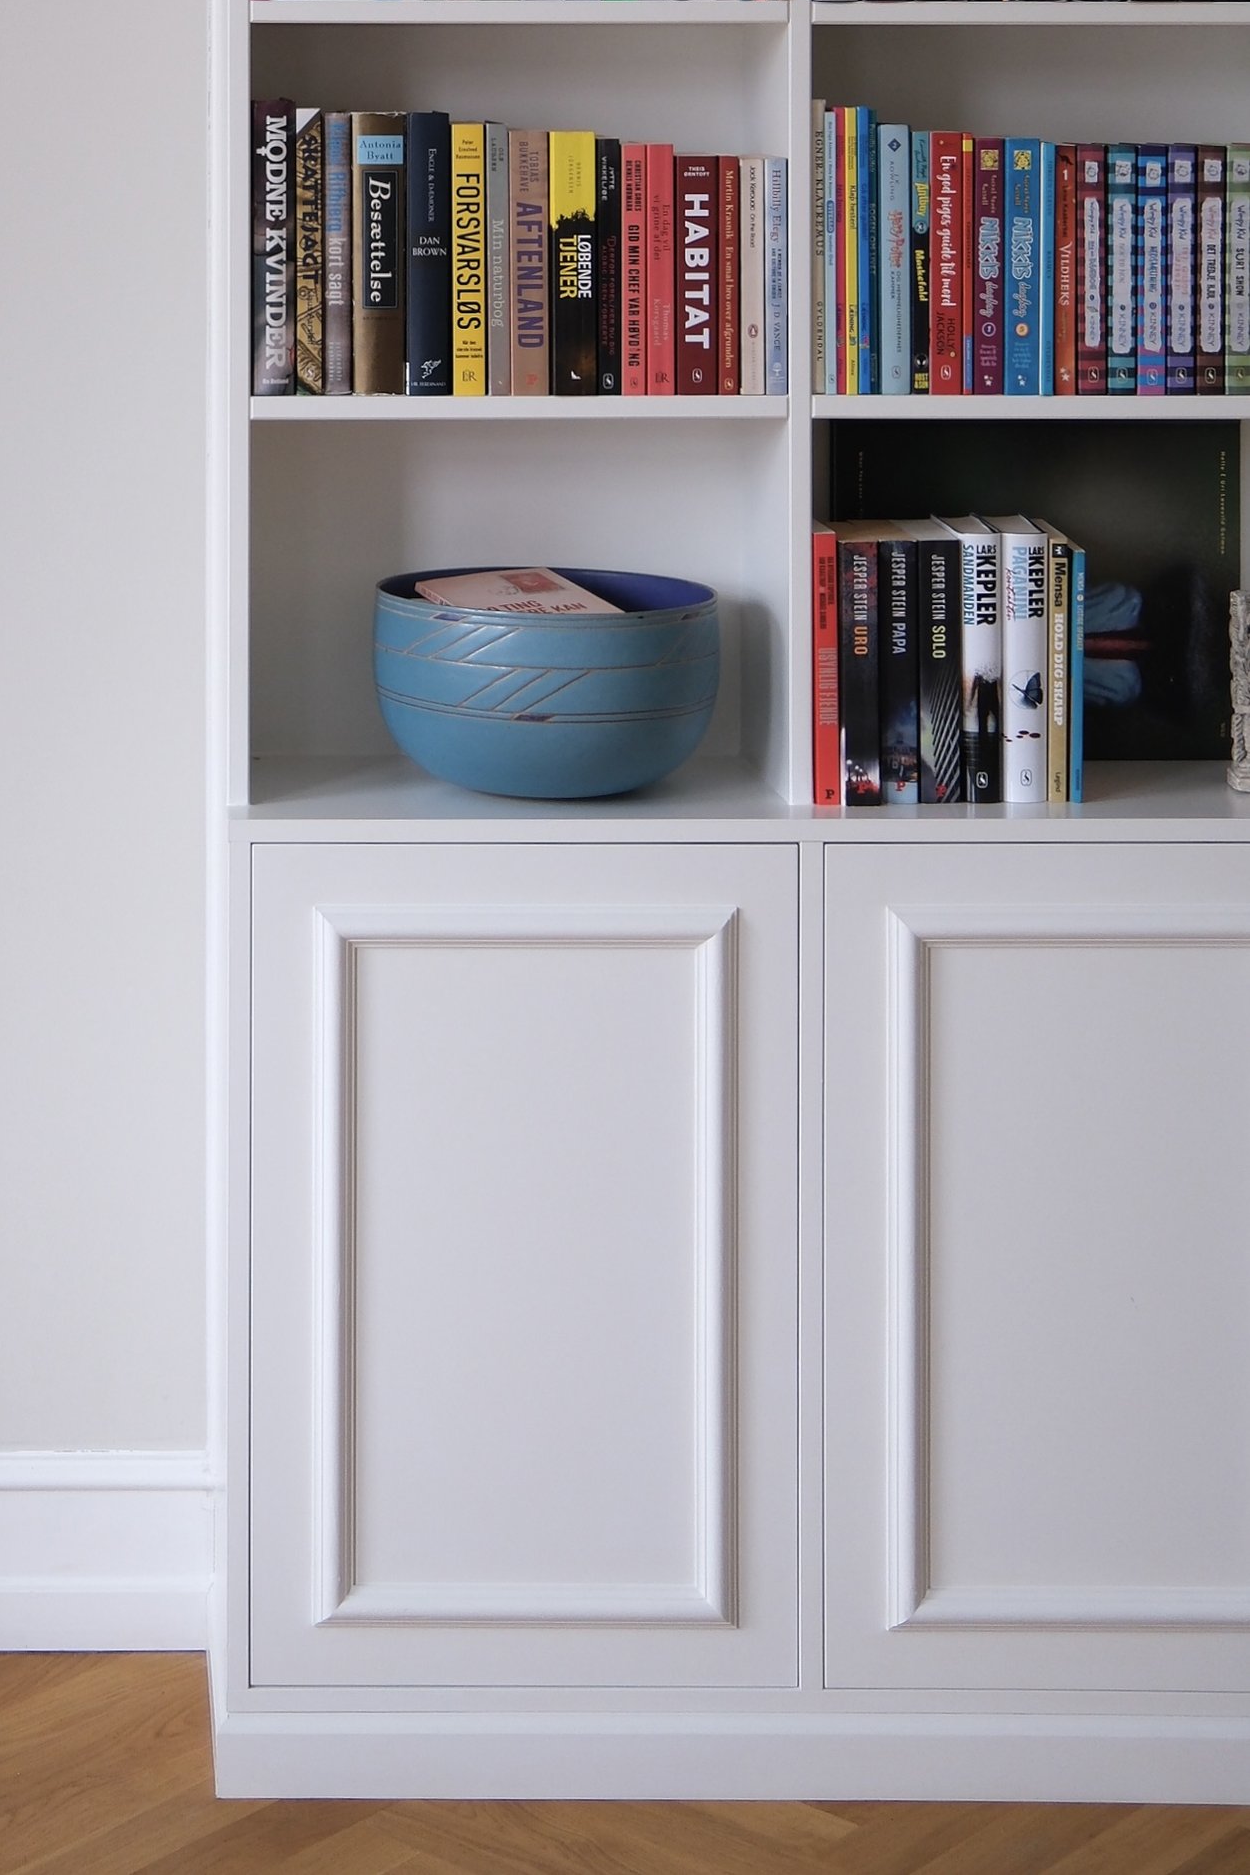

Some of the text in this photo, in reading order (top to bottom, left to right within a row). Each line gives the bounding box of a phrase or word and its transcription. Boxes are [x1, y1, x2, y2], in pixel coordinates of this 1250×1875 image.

[257, 115, 286, 369] MODNE KVINDER
[368, 177, 391, 302] Besættelse
[456, 173, 481, 329] FORSVARSLØS
[560, 235, 577, 298] TJENER
[578, 235, 591, 298] LØBENDE
[816, 179, 824, 257] KLATREMUS
[937, 156, 956, 306] En god piges guide til mord
[517, 202, 543, 348] AFTENLAND
[685, 193, 709, 349] HABITAT
[724, 171, 735, 368] Martin Krasnik En smal bro over afgrunden
[1059, 242, 1071, 306] VILDHEKS
[854, 555, 868, 655] JESPER STEIN URO
[891, 552, 906, 653] JESPER STEIN PAPA
[932, 555, 946, 658] JESPER STEIN SOLO
[963, 544, 974, 625] SANDMANDEN
[977, 545, 996, 625] LARS KEPLER
[1013, 546, 1027, 619] PAGANINI
[1028, 556, 1044, 618] KEPLER
[1053, 562, 1065, 725] Mensa HOLD DIG SHARP
